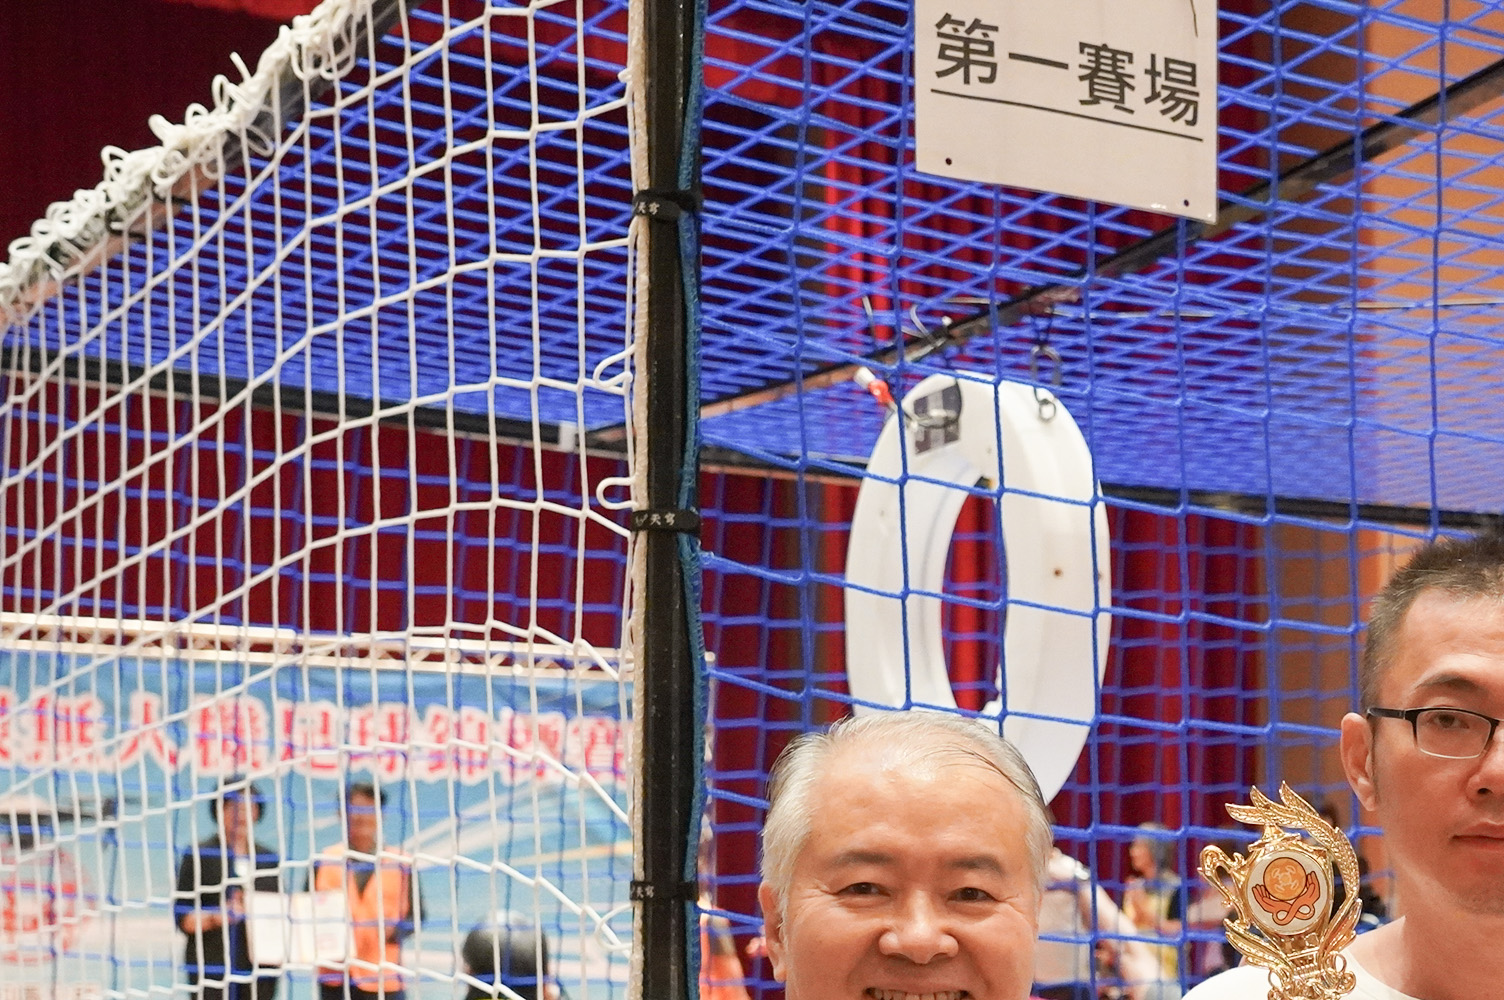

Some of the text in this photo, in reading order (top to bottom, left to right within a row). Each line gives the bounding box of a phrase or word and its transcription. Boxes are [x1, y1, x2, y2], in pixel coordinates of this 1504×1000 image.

[935, 12, 1200, 127] 第一賽場
[0, 690, 632, 784] 無人機足球錦標賽
